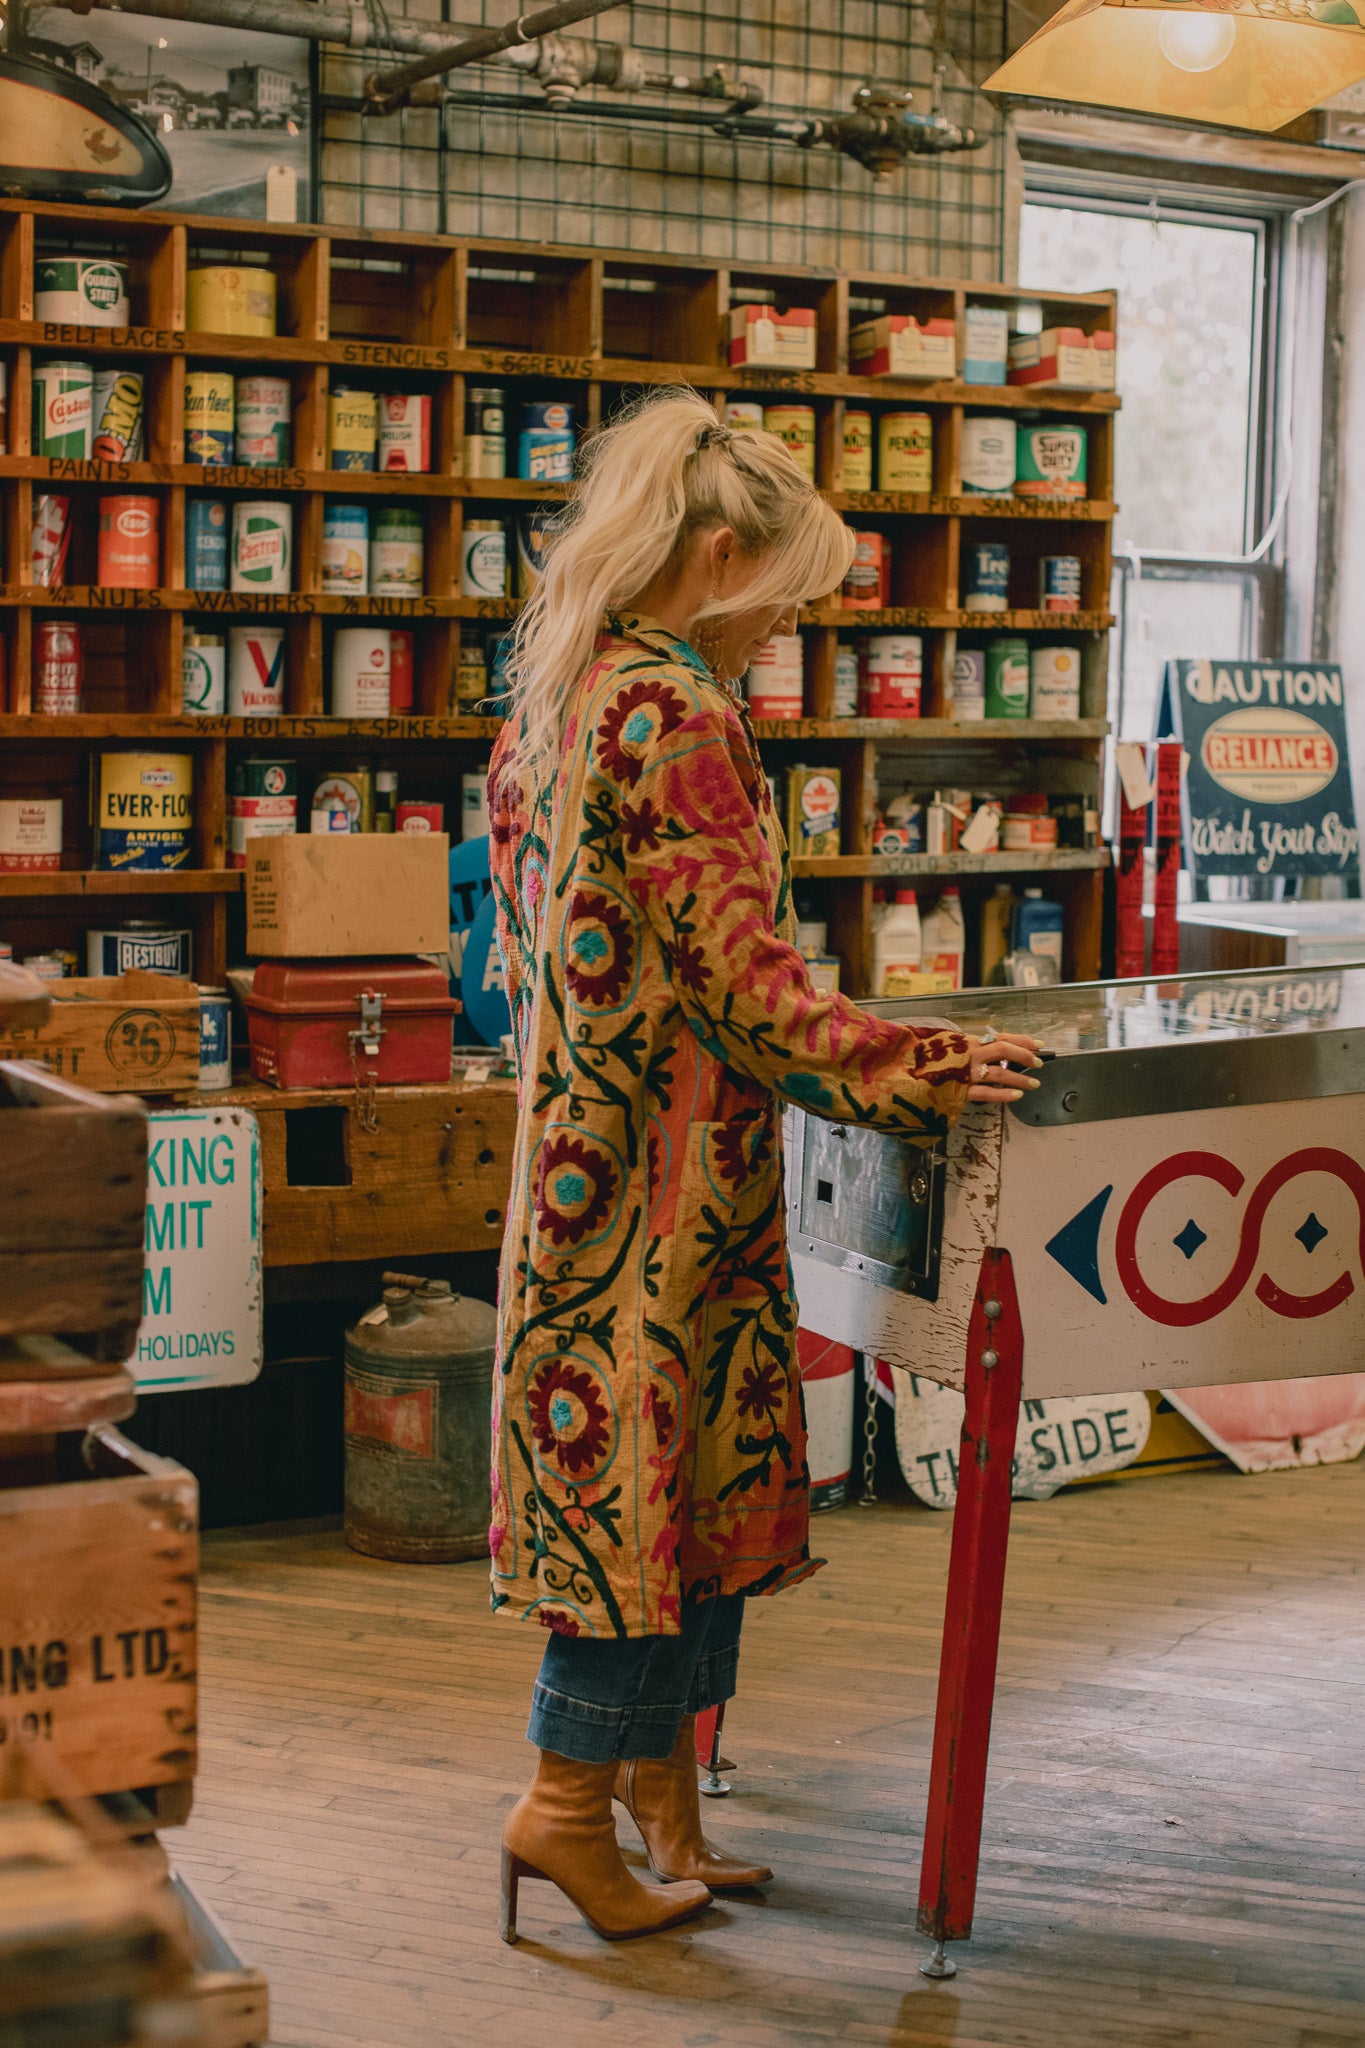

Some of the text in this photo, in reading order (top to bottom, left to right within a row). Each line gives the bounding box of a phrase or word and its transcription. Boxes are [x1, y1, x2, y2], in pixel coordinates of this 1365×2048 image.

[90, 288, 118, 302] STATE
[44, 323, 185, 349] BELT LACES
[344, 345, 449, 367] STENCILS
[50, 458, 130, 480] PAINTS
[203, 466, 305, 488] BRUSHES
[88, 585, 161, 607] NUTS
[194, 590, 316, 612] WASHERS
[369, 596, 437, 618] NUTS
[854, 609, 929, 626] SOLDER
[1186, 667, 1342, 706] CAUTION
[244, 719, 316, 737] BOLTS
[372, 719, 449, 737] SPIKES
[1209, 737, 1332, 769] RELIANCE
[1192, 808, 1257, 856] Watch
[146, 1134, 235, 1188] KING
[145, 1201, 212, 1252] MIT
[138, 1329, 236, 1362] HOLIDAYS
[1031, 1408, 1137, 1471] SIDE
[92, 1627, 182, 1684] LTD.
